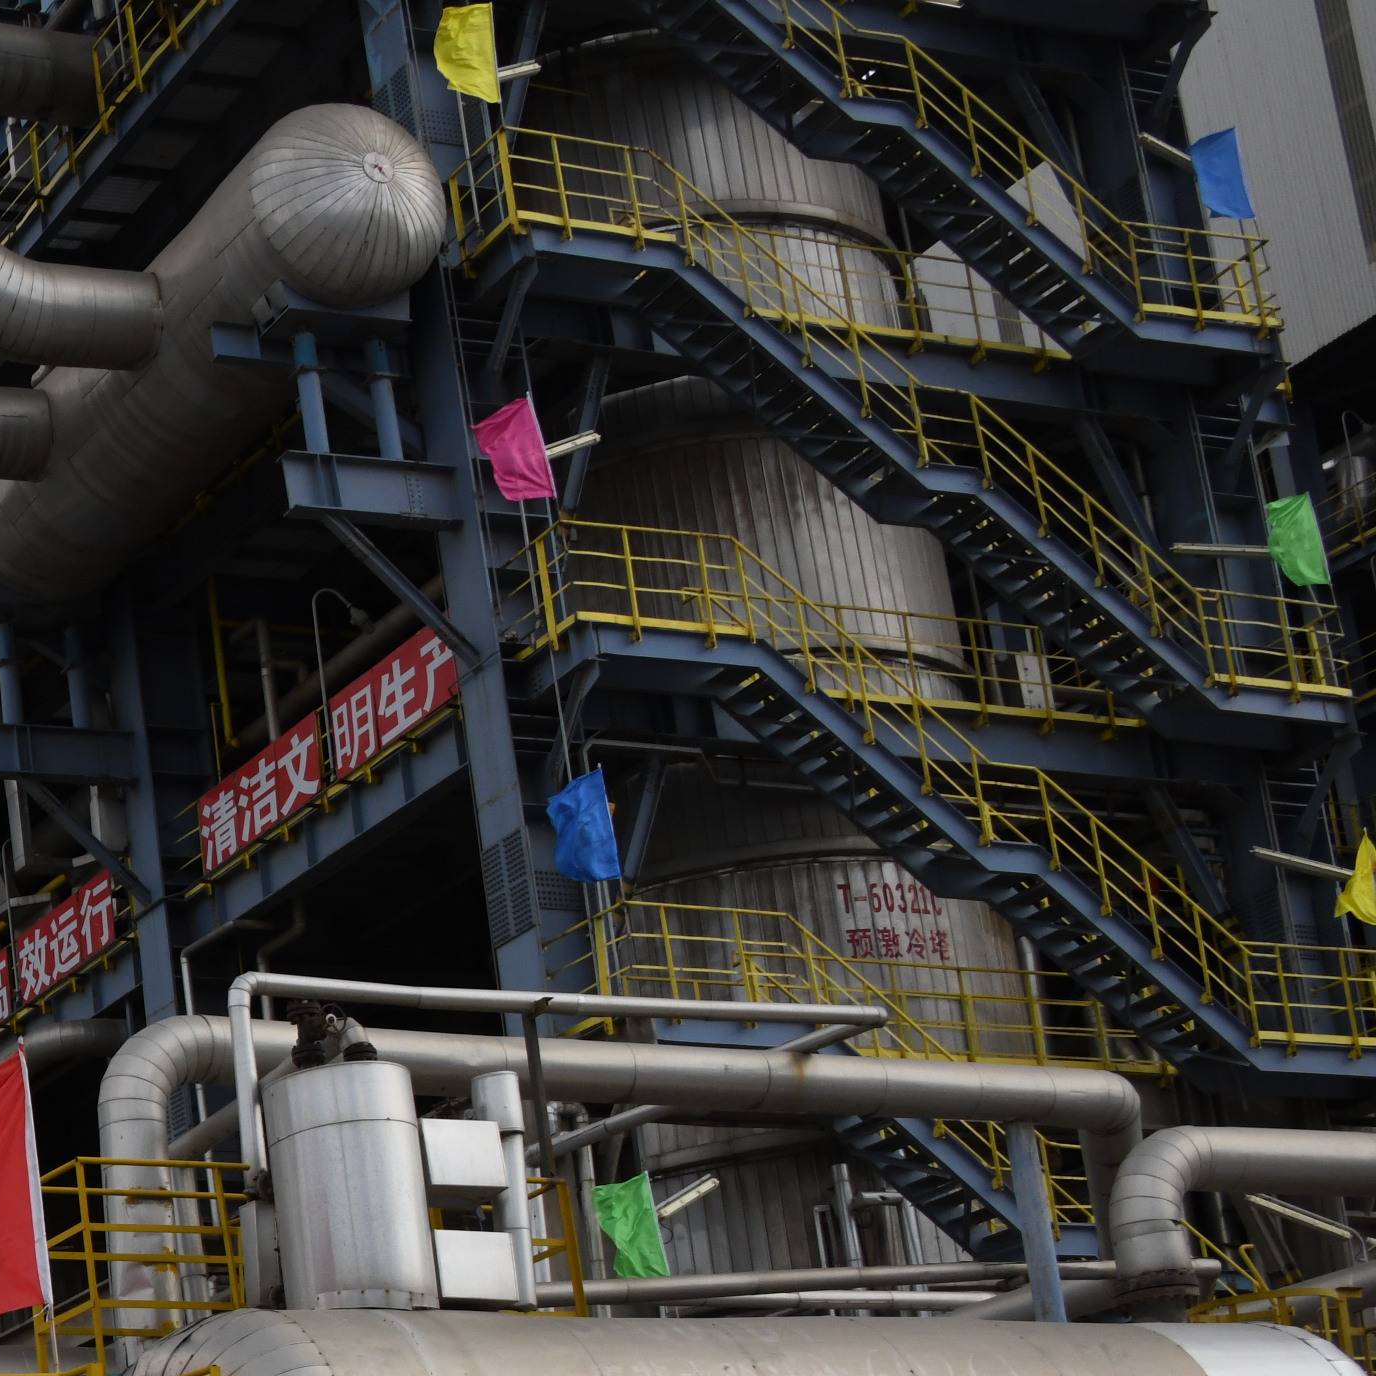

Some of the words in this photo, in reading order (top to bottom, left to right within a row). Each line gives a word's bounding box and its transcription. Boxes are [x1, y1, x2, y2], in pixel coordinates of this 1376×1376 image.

[200, 640, 454, 872] 清洁文明生产
